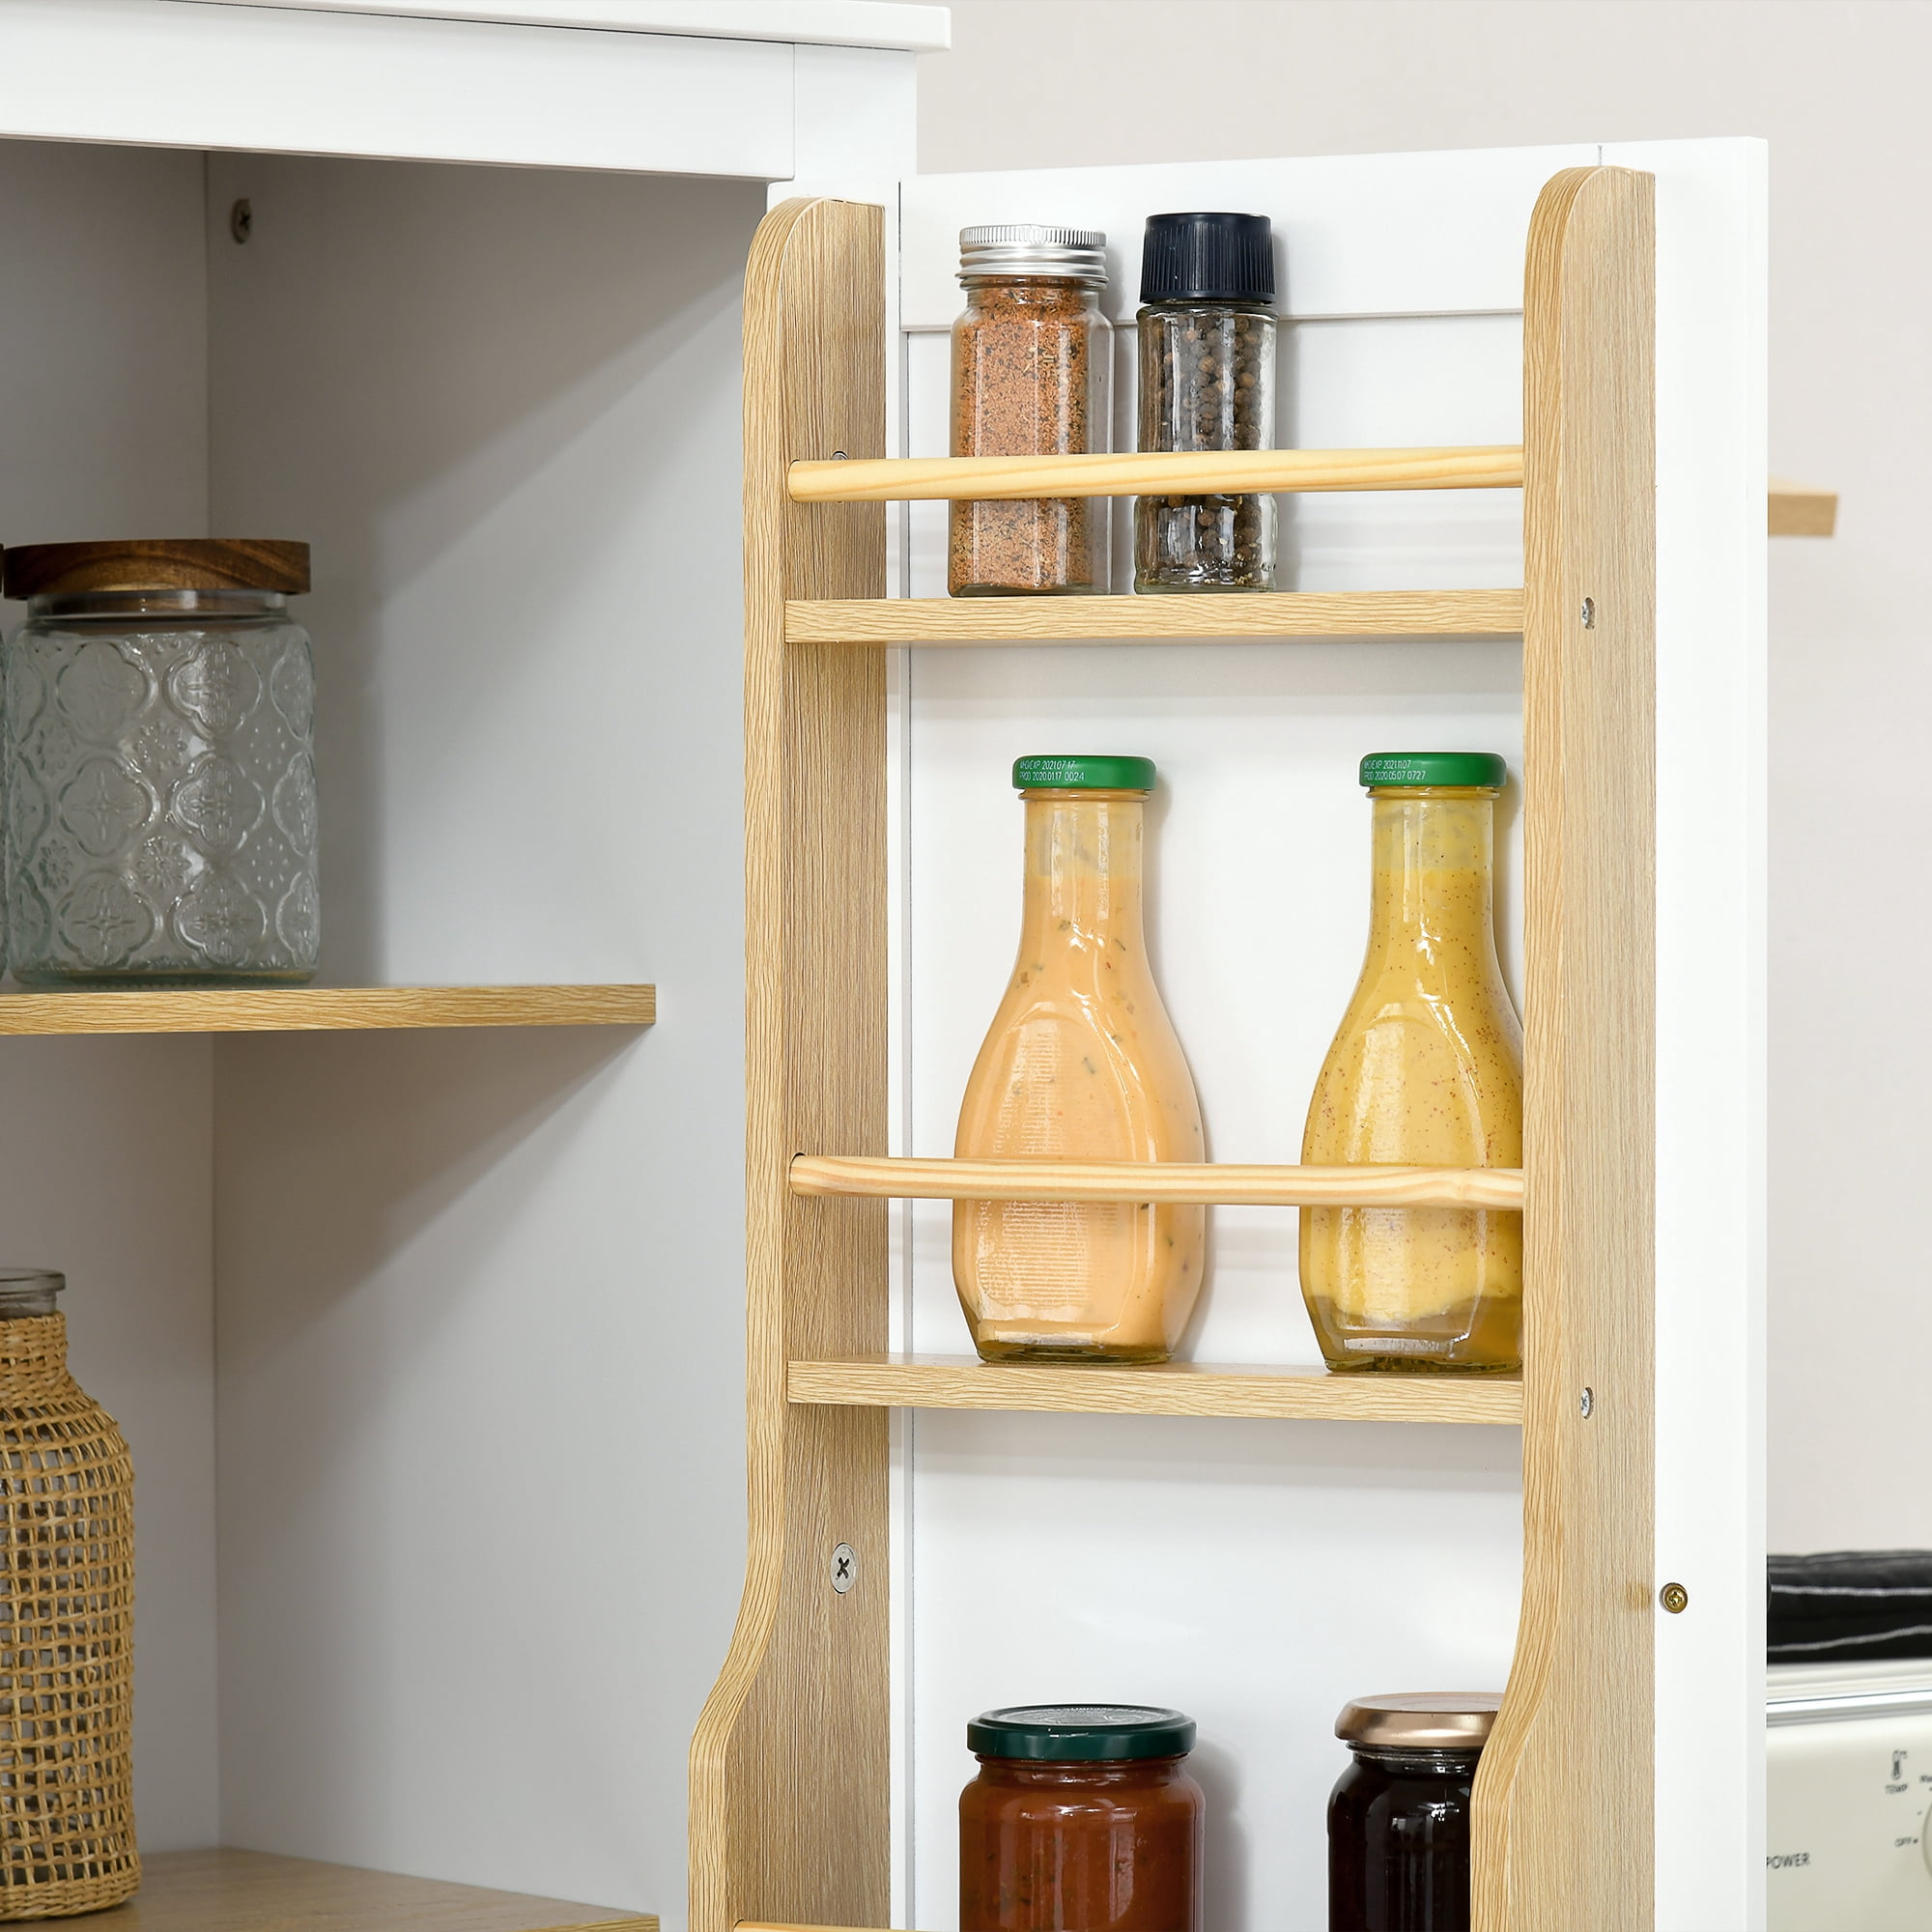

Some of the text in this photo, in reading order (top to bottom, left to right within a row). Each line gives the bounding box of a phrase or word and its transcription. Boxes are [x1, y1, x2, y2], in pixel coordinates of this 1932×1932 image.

[1065, 772, 1085, 781] 0024
[1406, 771, 1426, 781] 0727
[1767, 1852, 1811, 1869] POWER
